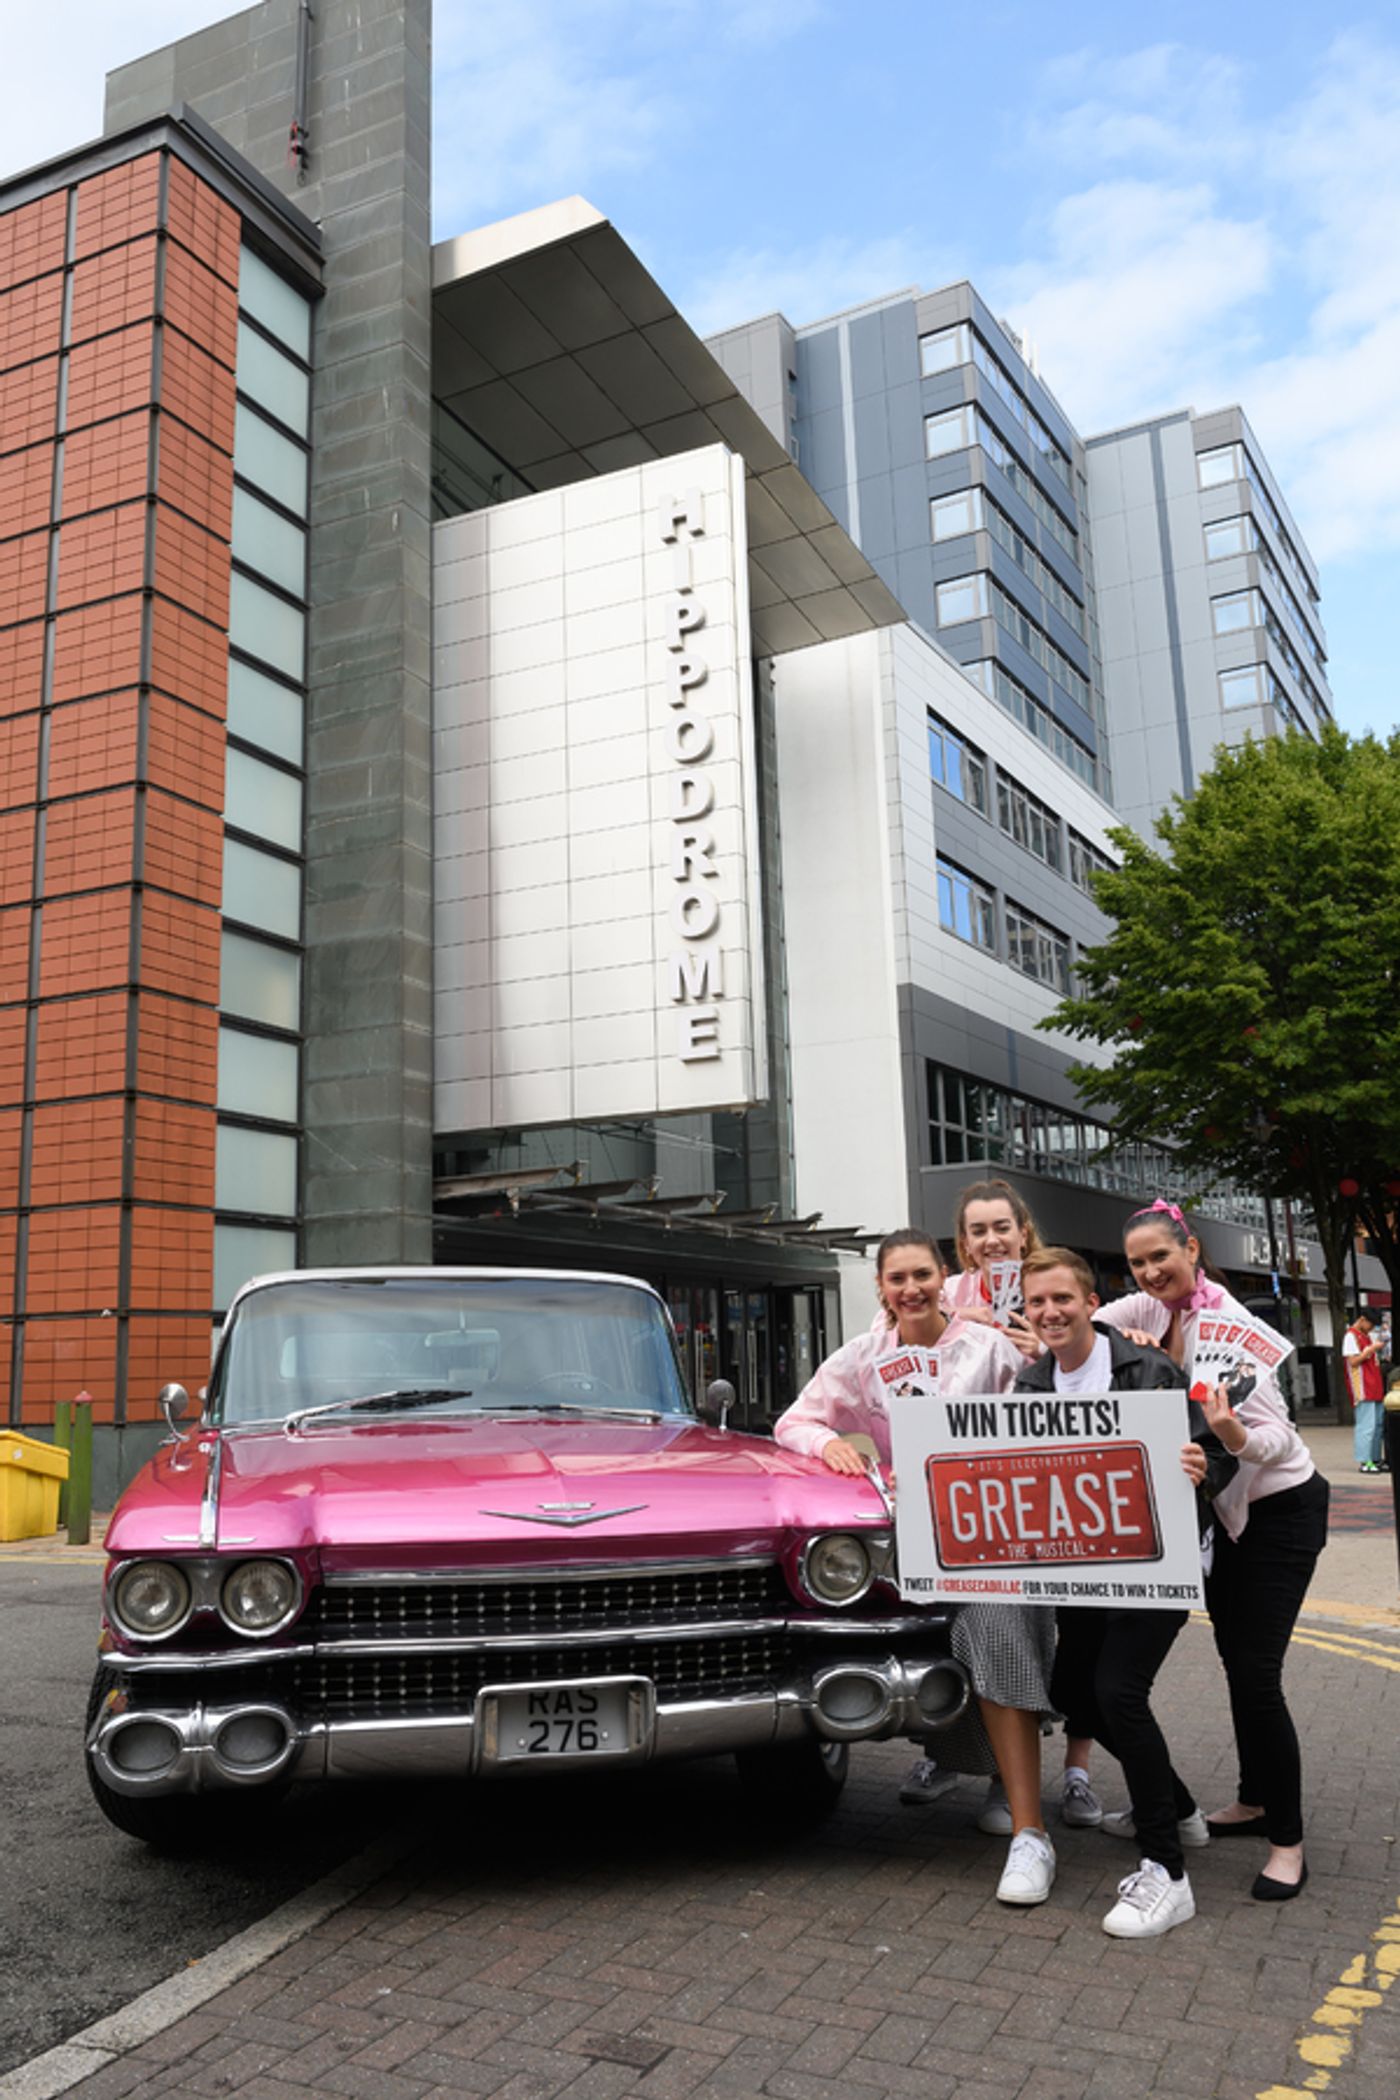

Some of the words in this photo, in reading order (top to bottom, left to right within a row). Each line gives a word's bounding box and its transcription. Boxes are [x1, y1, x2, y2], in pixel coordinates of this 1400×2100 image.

[660, 489, 724, 1063] HIPPODROME
[946, 1403, 997, 1437] WIN
[1003, 1400, 1122, 1437] TICKETS!
[948, 1470, 1142, 1543] GREASE
[1008, 1542, 1030, 1559] THE
[1034, 1540, 1088, 1558] MUSICAL
[903, 1577, 934, 1592] TWEET
[1023, 1580, 1042, 1595] FOR
[1043, 1581, 1069, 1596] YOUR
[1071, 1581, 1110, 1597] CHANCE
[1111, 1583, 1124, 1598] TO
[1125, 1583, 1147, 1598] WIN
[1148, 1583, 1156, 1599] 2
[1157, 1583, 1199, 1600] TICKETS
[528, 1688, 599, 1715] RAS
[527, 1719, 599, 1752] 276
